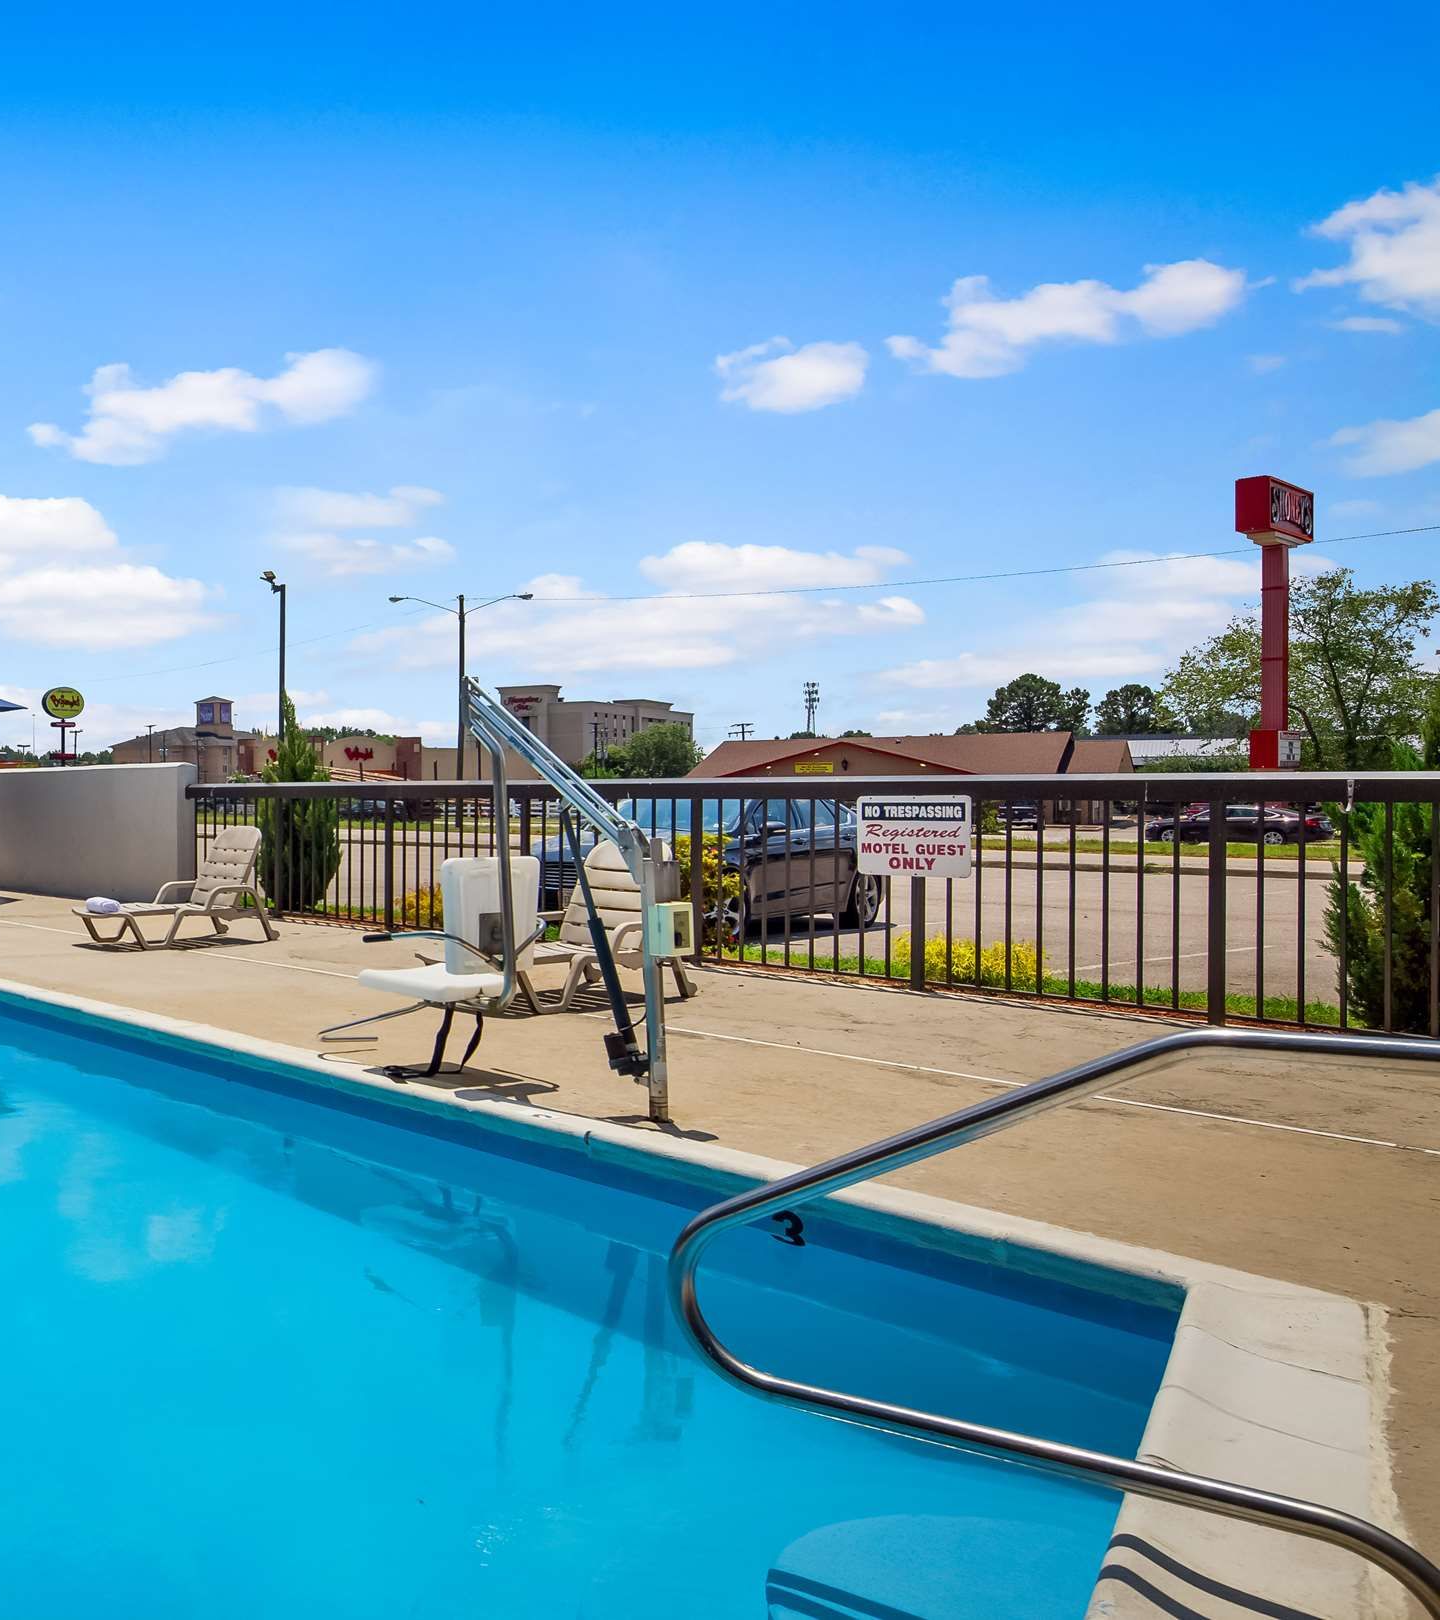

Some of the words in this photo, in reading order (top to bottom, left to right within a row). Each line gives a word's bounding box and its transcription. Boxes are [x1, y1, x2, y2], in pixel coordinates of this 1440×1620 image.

[864, 805, 880, 818] NO
[884, 805, 962, 818] TRESPASSING
[865, 823, 961, 841] Registered
[861, 843, 909, 854] MOTEL
[915, 844, 966, 856] GUEST
[888, 857, 936, 870] ONLY
